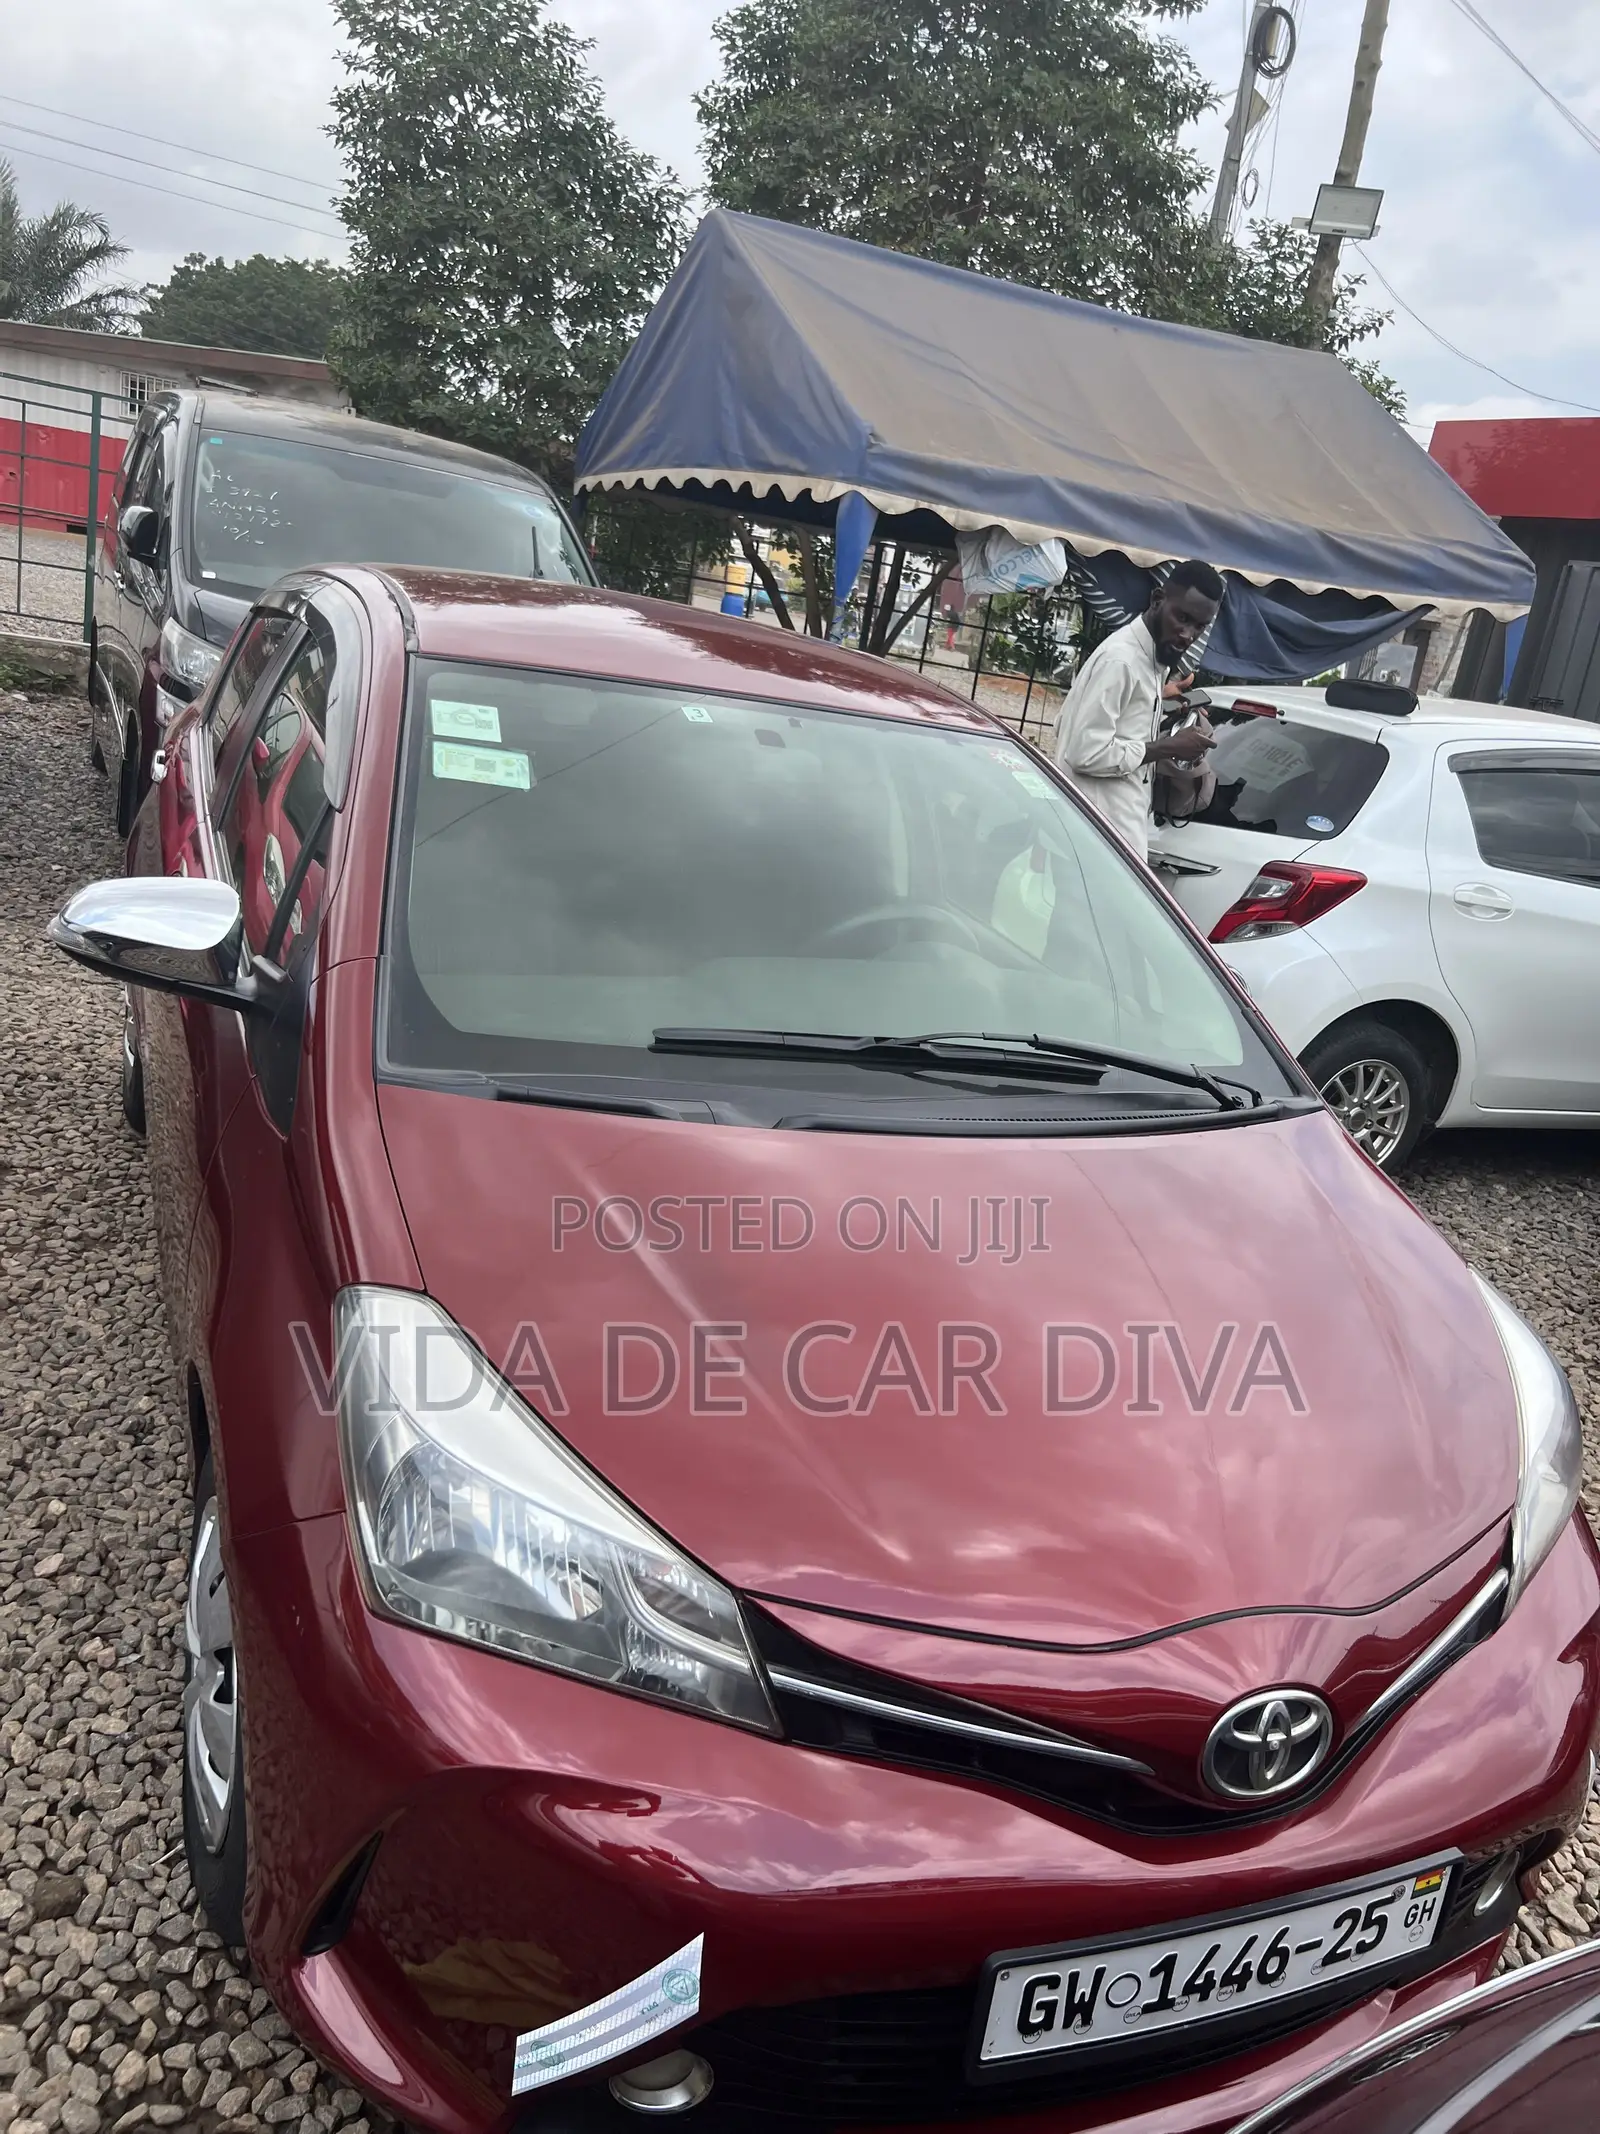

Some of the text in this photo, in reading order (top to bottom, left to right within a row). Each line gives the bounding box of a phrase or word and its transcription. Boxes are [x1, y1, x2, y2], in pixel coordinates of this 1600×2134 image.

[1403, 1897, 1437, 1929] GH
[1018, 1894, 1397, 2035] GW 1446-25
